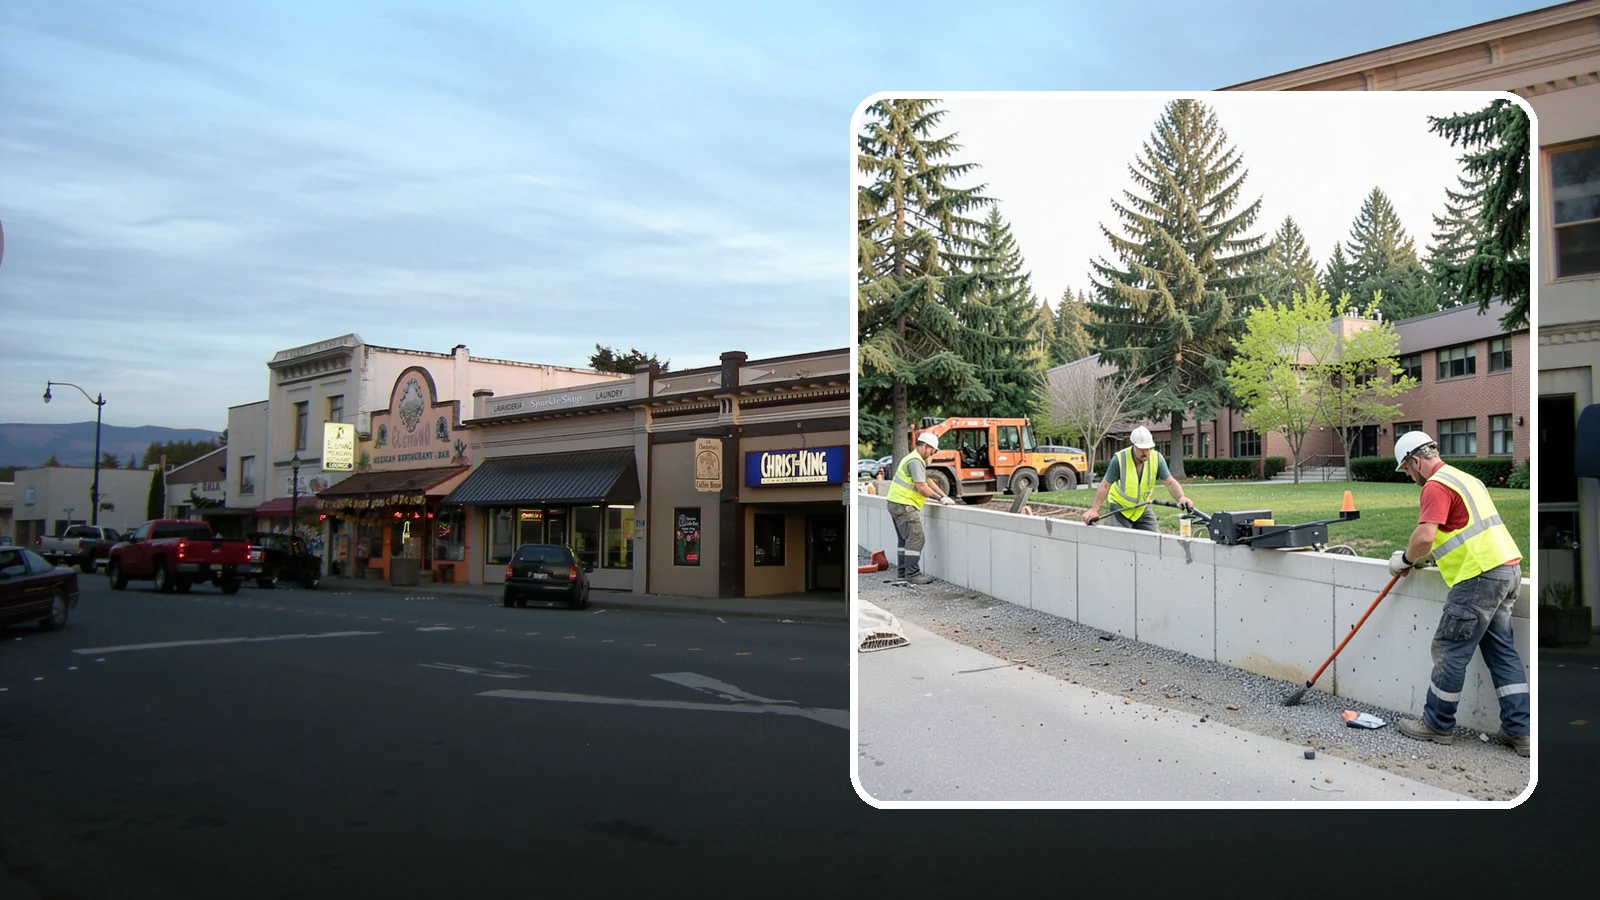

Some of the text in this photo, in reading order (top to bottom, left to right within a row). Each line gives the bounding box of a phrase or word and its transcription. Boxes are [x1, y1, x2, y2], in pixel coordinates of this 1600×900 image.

[493, 402, 523, 413] LAVANDERIA
[562, 394, 582, 406] Shop
[595, 389, 624, 400] LAUNDRY
[373, 454, 396, 464] MEXICAN
[397, 451, 433, 462] RESTAURANT
[438, 450, 450, 459] BAR
[761, 450, 827, 478] CHRIST KING
[696, 481, 709, 489] Coffee
